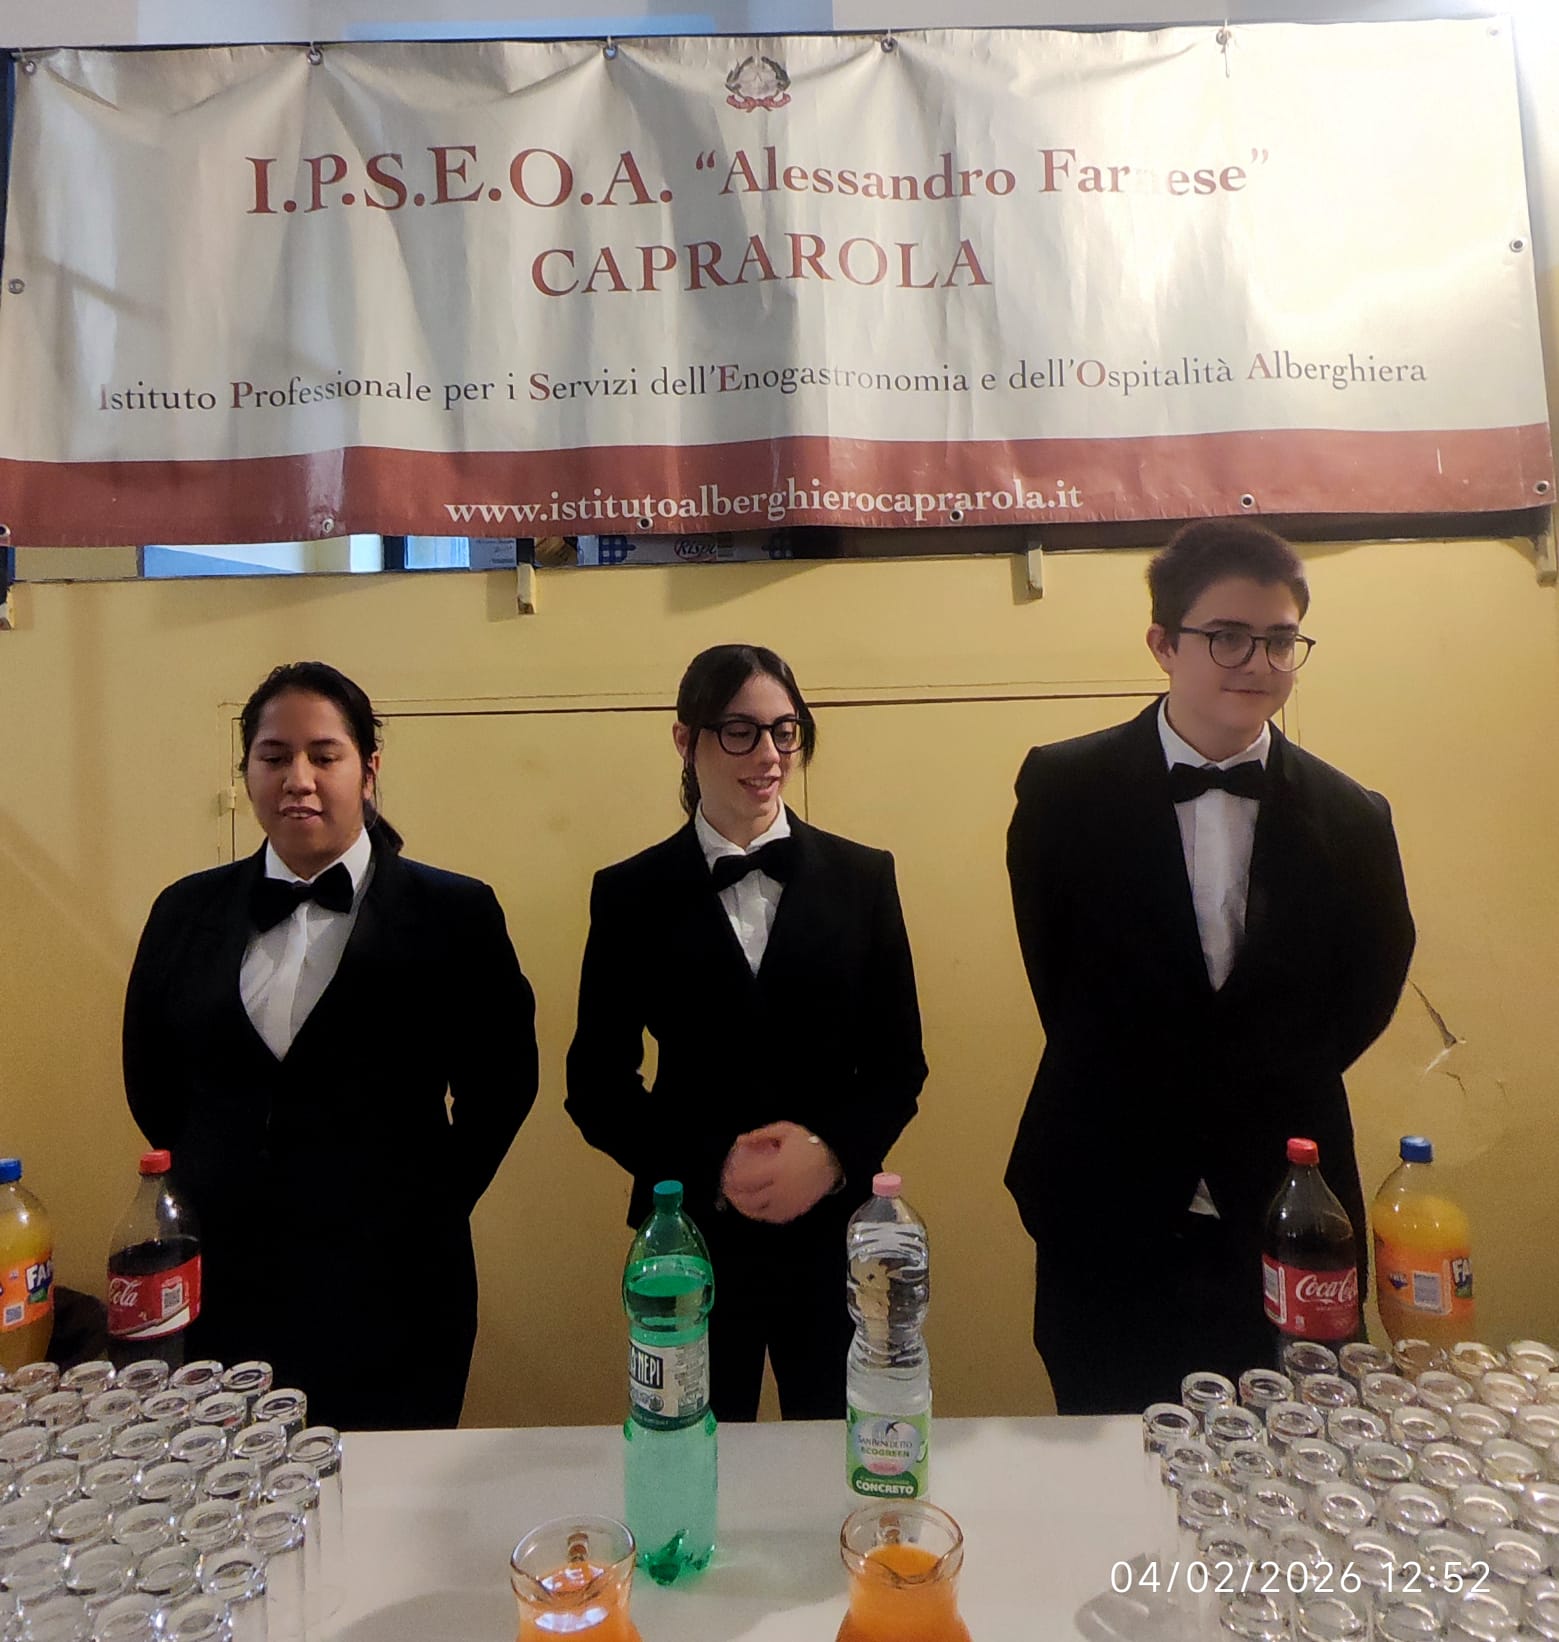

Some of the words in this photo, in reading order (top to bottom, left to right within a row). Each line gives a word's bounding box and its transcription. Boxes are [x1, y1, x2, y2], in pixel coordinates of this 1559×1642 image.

[246, 145, 673, 214] I.P.S.E.O.A.
[695, 146, 1016, 200] “Alessandro
[1037, 147, 1268, 196] Farese”
[531, 232, 992, 297] CAPRAROLA
[99, 380, 217, 410] Istituto
[230, 370, 431, 409] Professionale
[444, 381, 495, 410] per
[507, 372, 516, 400] i
[529, 368, 638, 401] Servizi
[650, 364, 970, 394] dell’Enogastronomia
[981, 374, 996, 391] e
[1009, 356, 1233, 396] dell’Ospitalità
[1248, 351, 1427, 390] Alberghiera
[444, 477, 1083, 522] www.istitutoalberghierocaprarola.it
[638, 1351, 660, 1386] NEPI
[855, 1479, 914, 1495] CONCRETO
